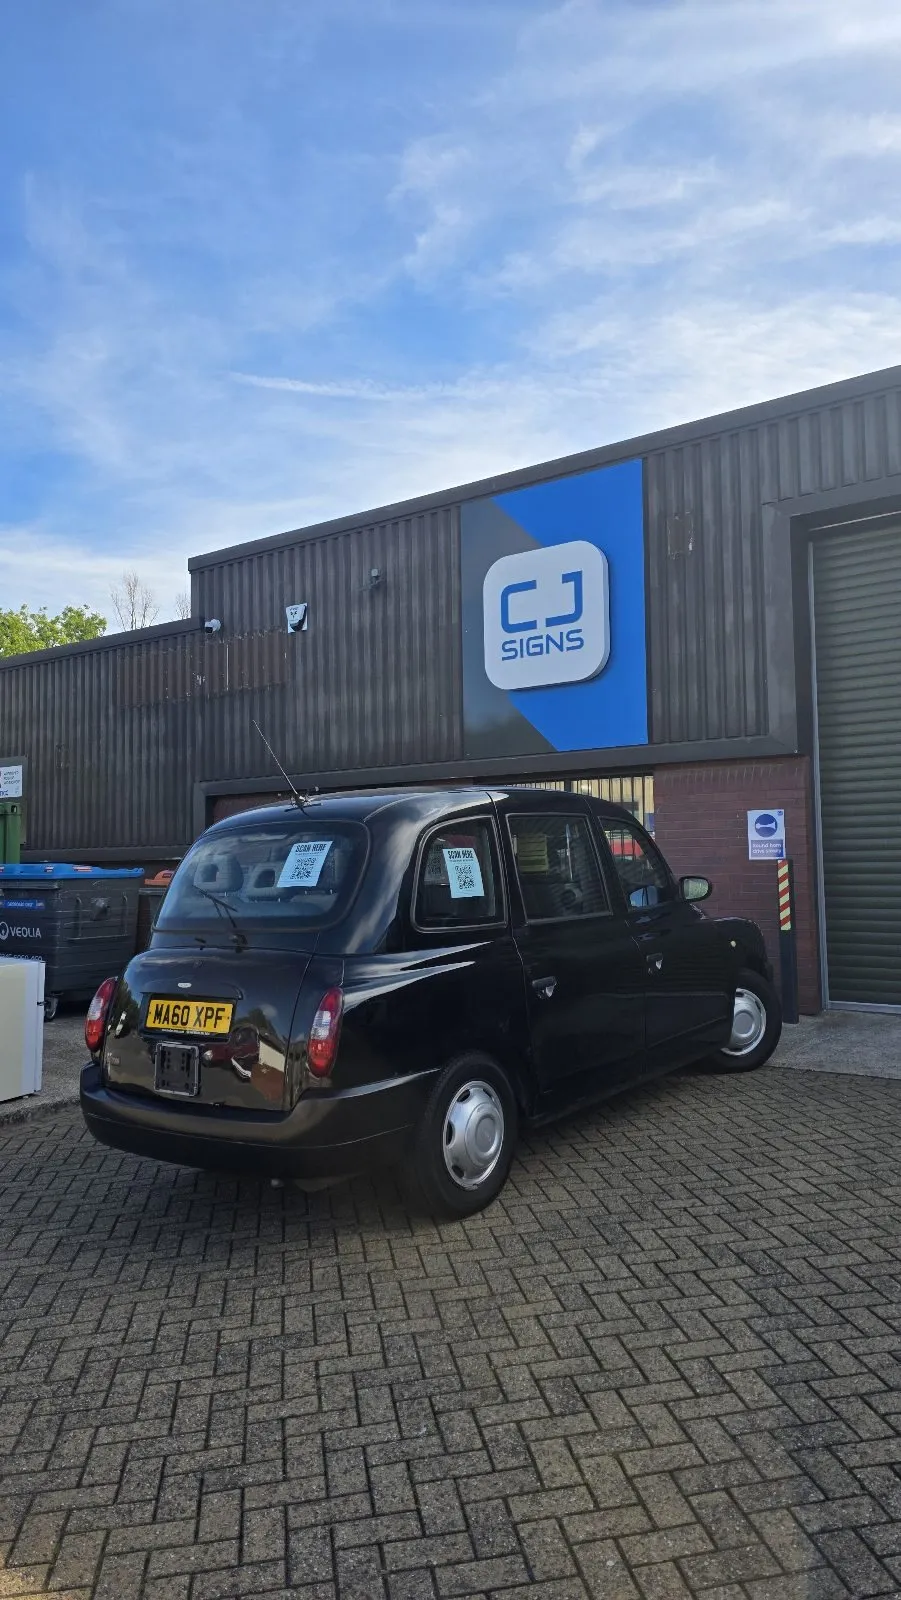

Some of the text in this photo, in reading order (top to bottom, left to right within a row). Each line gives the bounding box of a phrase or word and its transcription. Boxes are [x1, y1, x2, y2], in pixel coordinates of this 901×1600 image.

[500, 570, 583, 634] CJ
[501, 629, 585, 661] SIGNS
[295, 843, 327, 853] SCAN HERE
[448, 850, 474, 860] SCAN HERE
[9, 927, 41, 938] VEOLIA
[152, 1003, 226, 1029] MA60 XPF
